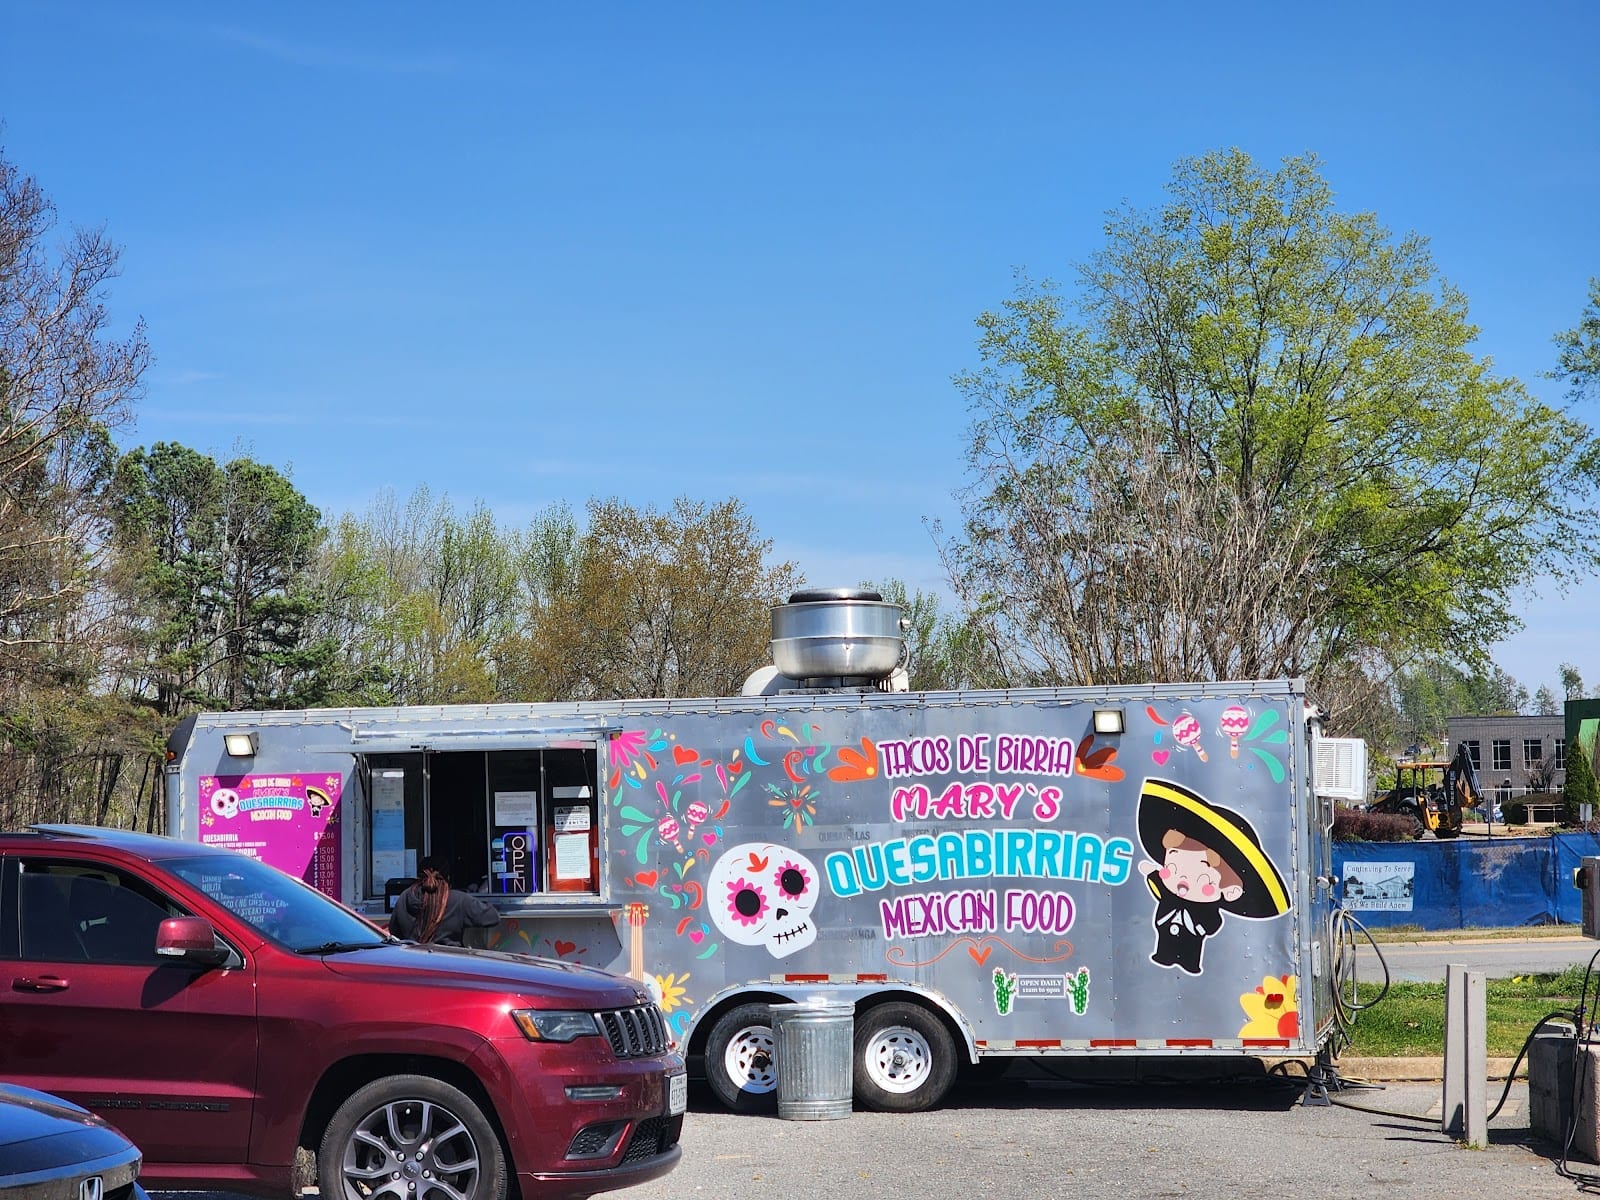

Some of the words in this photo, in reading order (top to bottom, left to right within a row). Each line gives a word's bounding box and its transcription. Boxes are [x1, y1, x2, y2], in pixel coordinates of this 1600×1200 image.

[879, 737, 950, 777] TACOS
[959, 736, 989, 771] DE
[511, 835, 526, 893] OPEN
[826, 831, 1132, 896] QUESABIRRIAS
[1393, 865, 1411, 873] Serve
[1006, 892, 1073, 933] FOOD
